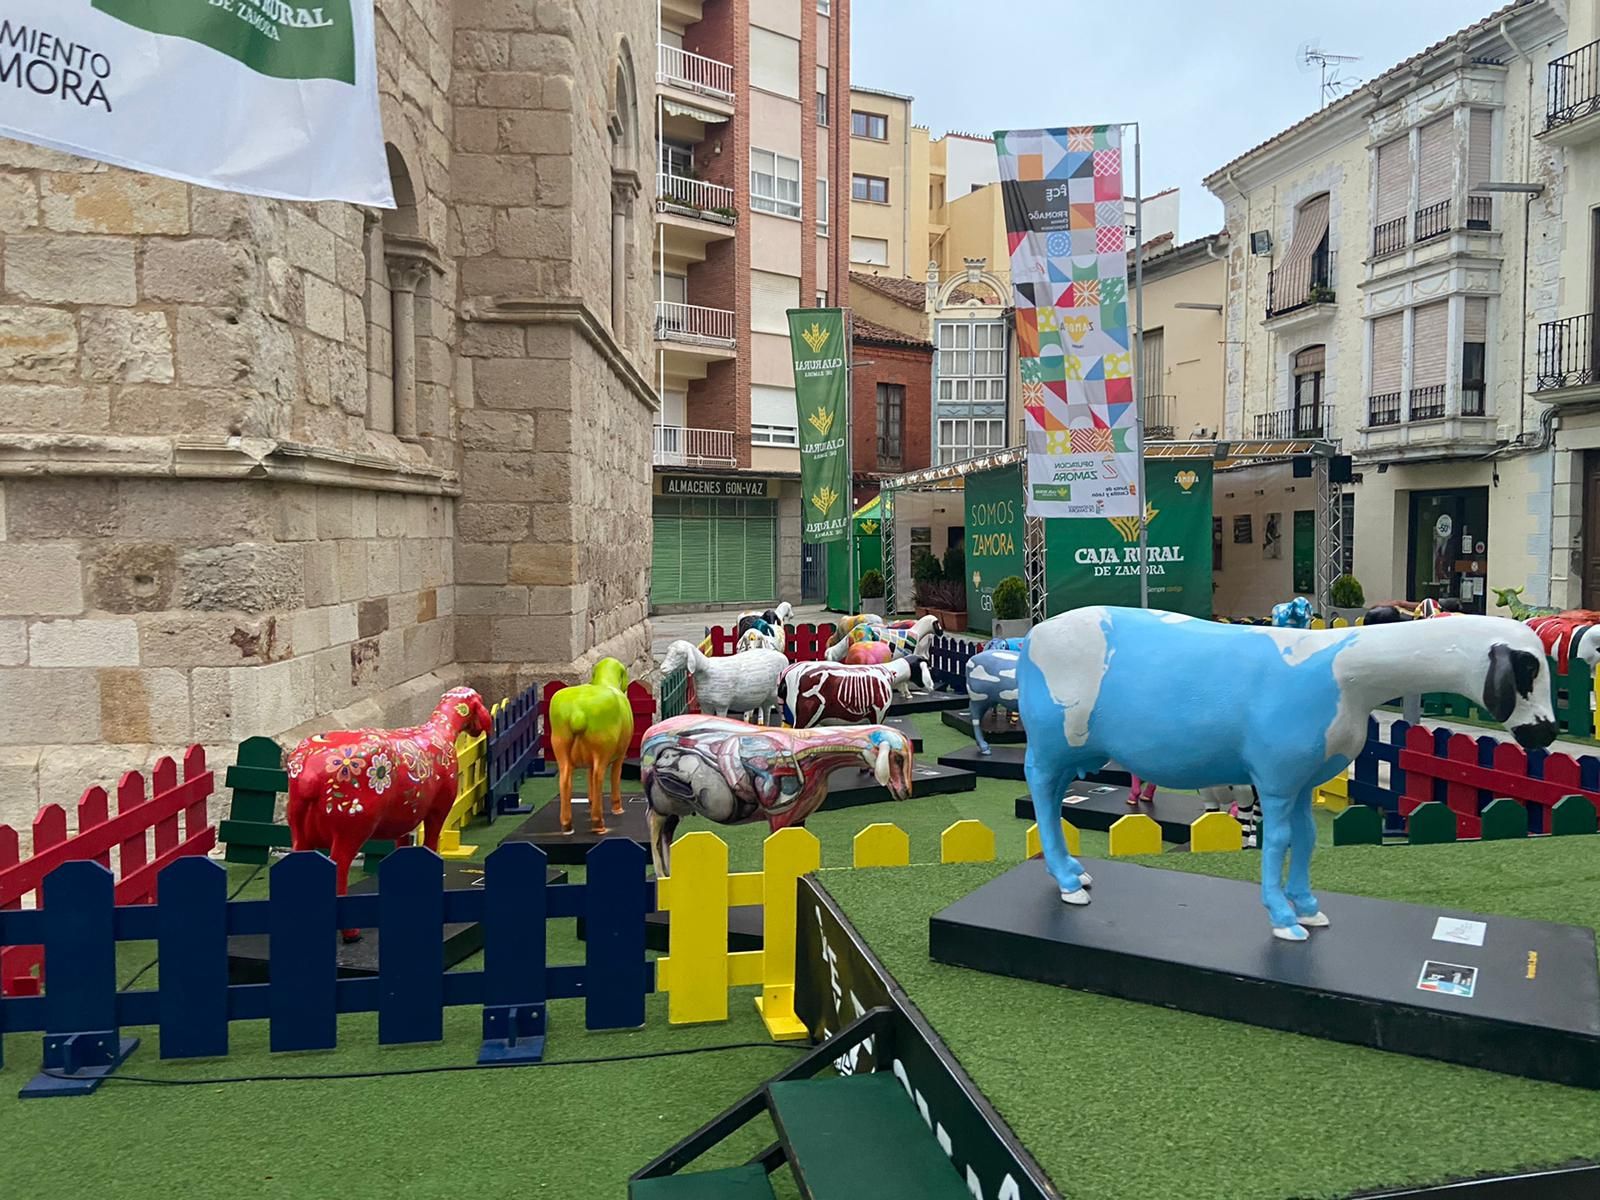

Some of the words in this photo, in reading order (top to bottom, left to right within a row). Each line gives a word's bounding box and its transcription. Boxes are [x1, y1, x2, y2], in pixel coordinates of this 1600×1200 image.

[0, 19, 111, 79] MIENTO
[668, 480, 720, 494] ALMACENES
[725, 482, 763, 495] GON-VAZ
[972, 500, 1014, 527] SOMOS
[972, 532, 1015, 556] ZAMORA
[1074, 547, 1120, 564] CAJA
[1094, 566, 1111, 576] DE
